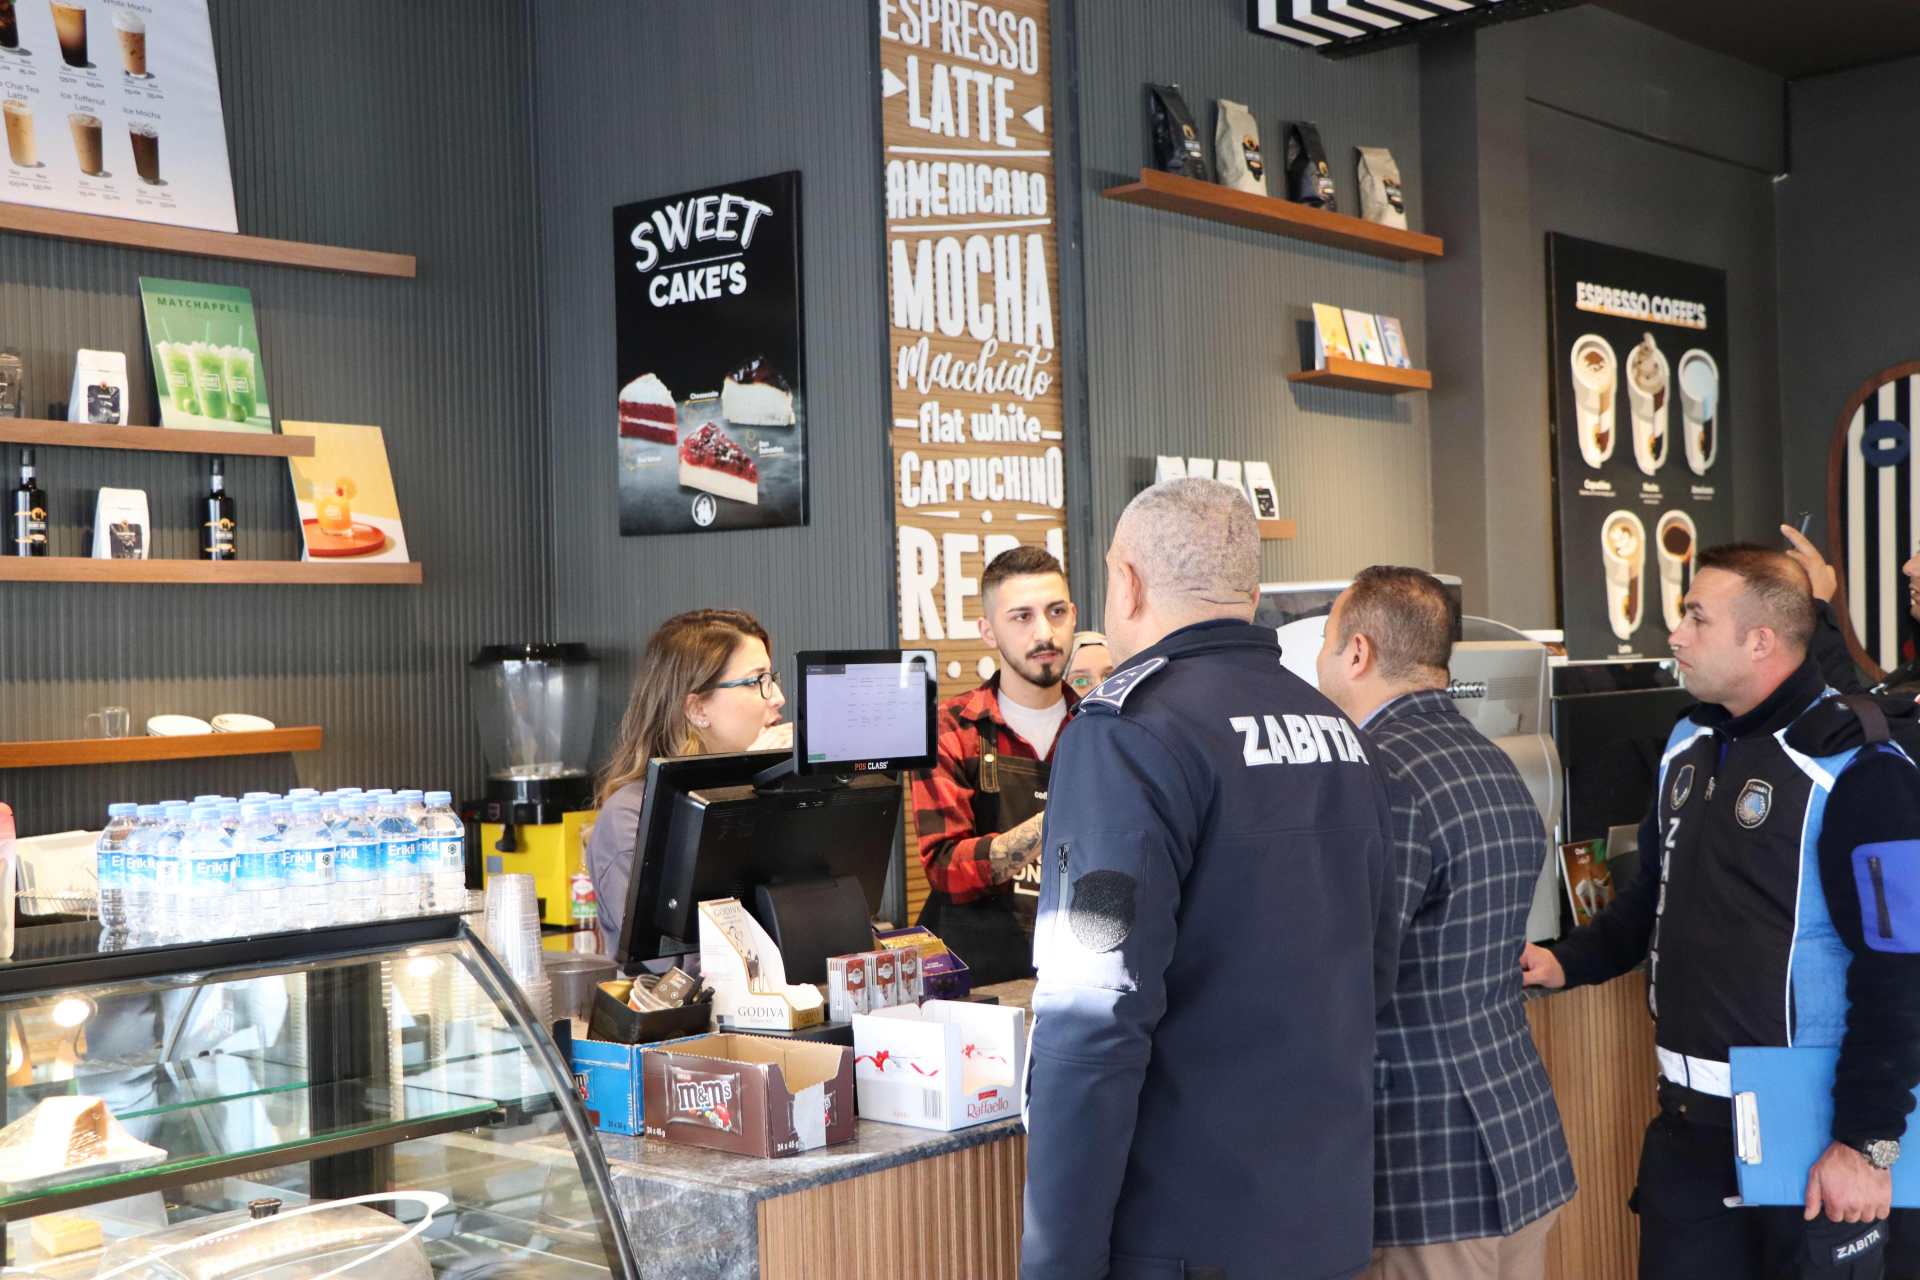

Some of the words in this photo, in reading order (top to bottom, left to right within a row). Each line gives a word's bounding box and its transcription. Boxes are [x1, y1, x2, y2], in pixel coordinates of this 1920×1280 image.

[880, 0, 1039, 75] ESPRESSO
[60, 91, 73, 100] Ice
[135, 109, 161, 120] Mocha
[907, 54, 1017, 148] LATTE
[886, 159, 1048, 219] AMERICANO
[630, 193, 774, 272] SWEET
[157, 296, 241, 314] MATCHAPPLE
[649, 261, 747, 307] CAKE'S
[891, 233, 1055, 348] MOCHA
[1576, 281, 1650, 318] ESPRESSO
[897, 337, 1053, 401] Macchiato
[919, 400, 966, 443] flat
[971, 402, 1041, 443] white
[901, 446, 1064, 509] CAPPUCHINO
[1229, 714, 1370, 767] ZABITA
[868, 761, 888, 770] CLASS
[738, 1006, 785, 1018] GODIVA
[967, 1096, 1009, 1119] Raffaello
[1836, 1229, 1881, 1260] ZABITA
